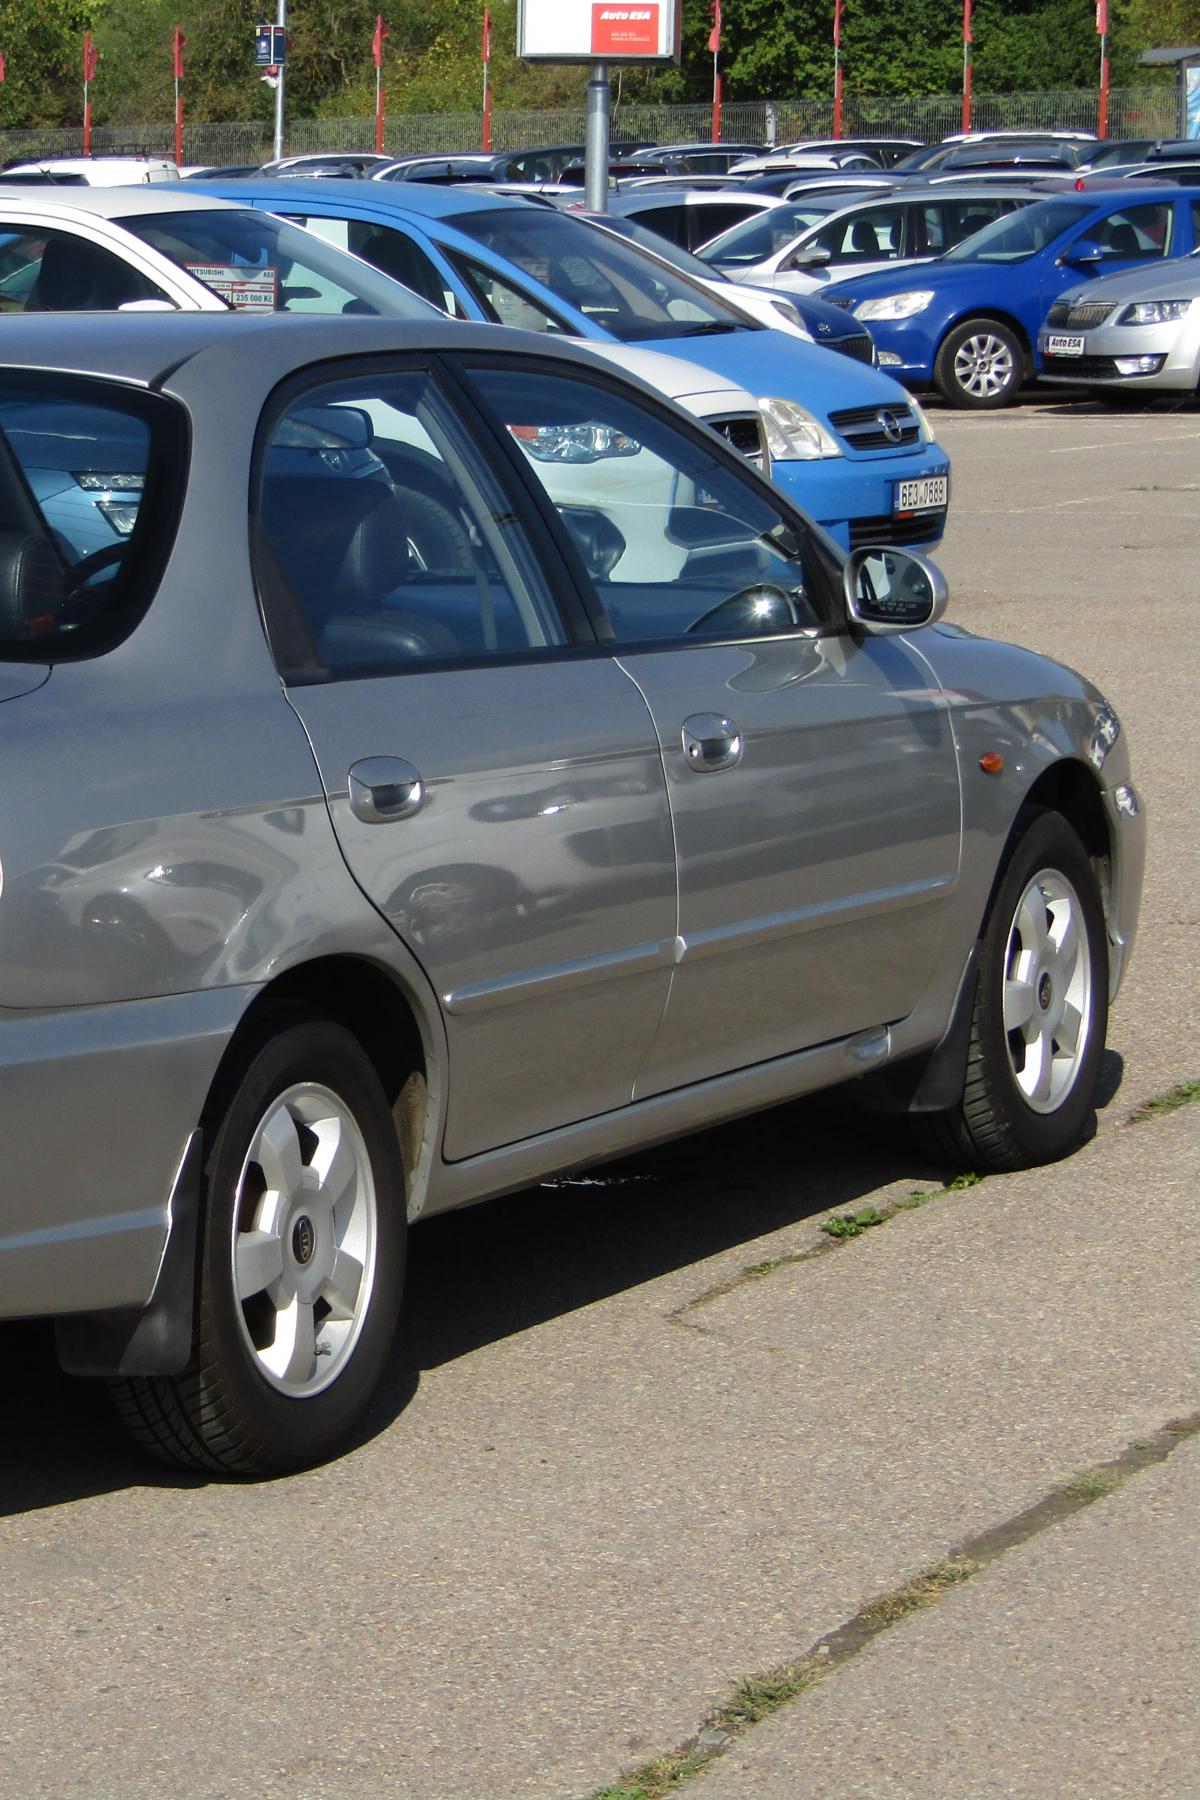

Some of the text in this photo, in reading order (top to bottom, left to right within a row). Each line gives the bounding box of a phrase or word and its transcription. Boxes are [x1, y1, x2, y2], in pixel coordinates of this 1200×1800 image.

[600, 11, 651, 20] Auto ESA
[250, 294, 263, 303] 000
[1051, 337, 1081, 348] Auto ESA
[901, 483, 918, 507] 6E3
